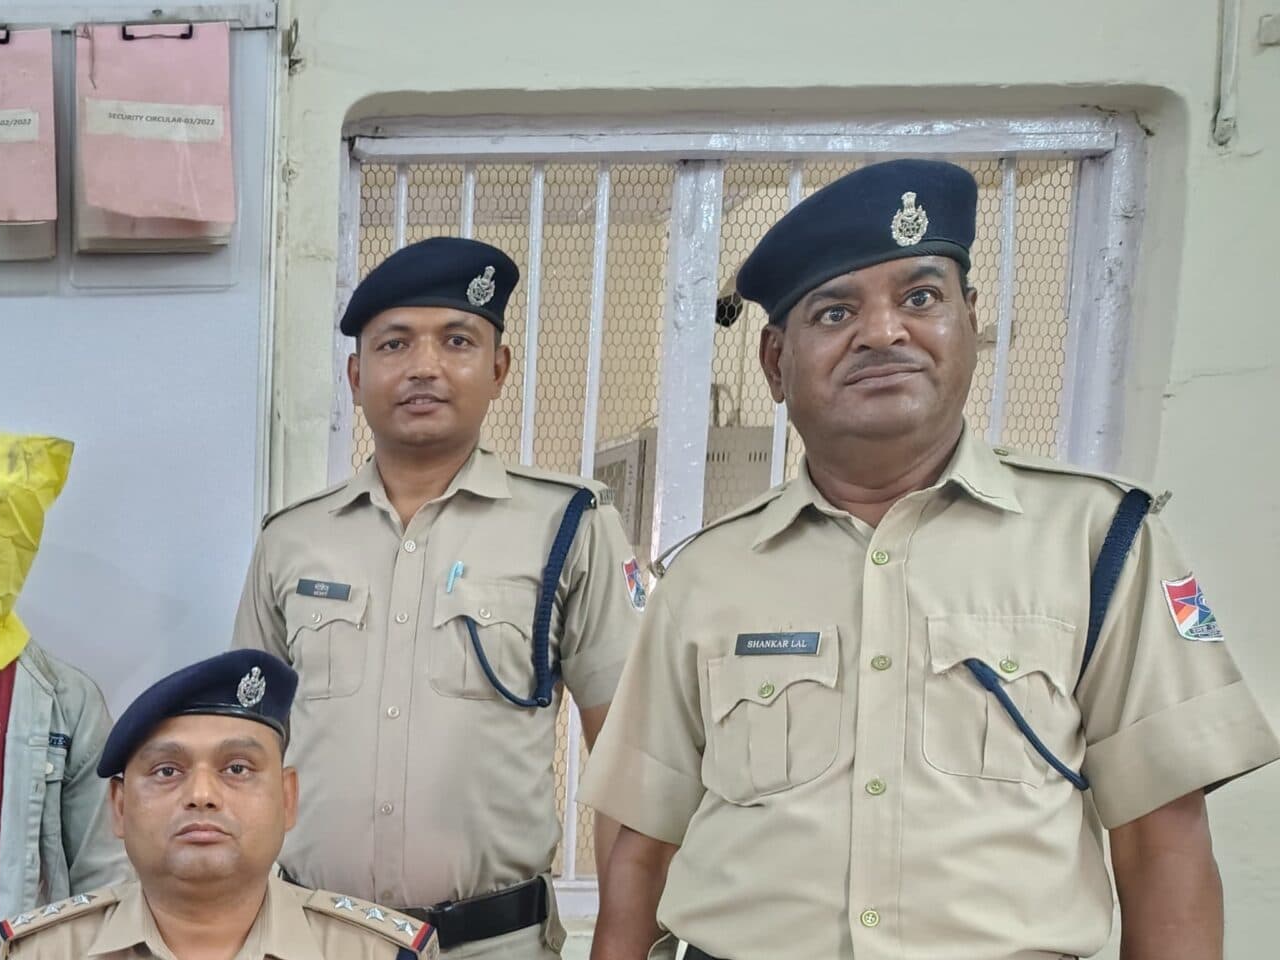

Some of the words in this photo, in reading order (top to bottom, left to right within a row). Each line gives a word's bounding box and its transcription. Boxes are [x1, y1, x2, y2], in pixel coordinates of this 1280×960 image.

[108, 112, 143, 121] SECURITY
[746, 640, 789, 649] SHANKAR
[790, 640, 808, 648] LAL
